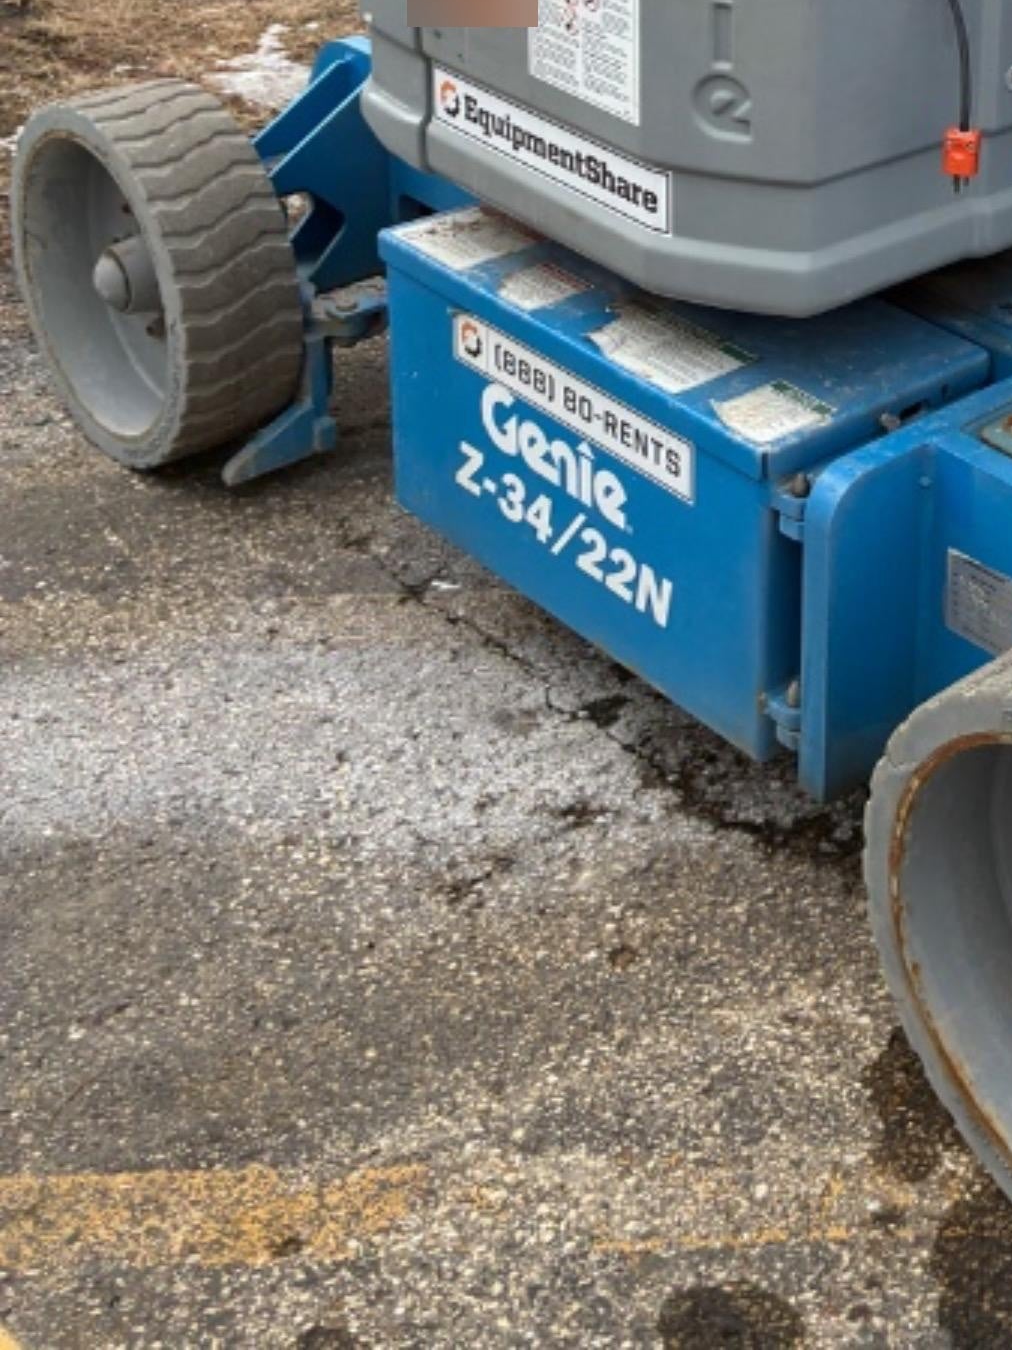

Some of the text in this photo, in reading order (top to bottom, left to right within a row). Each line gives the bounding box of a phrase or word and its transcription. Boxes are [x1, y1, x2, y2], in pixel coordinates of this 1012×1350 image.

[464, 94, 658, 214] EquipmentShare
[481, 382, 627, 532] Genie
[494, 344, 556, 403] (888)
[562, 384, 682, 479] 80-RENTS
[454, 440, 673, 628] Z-34/22N
